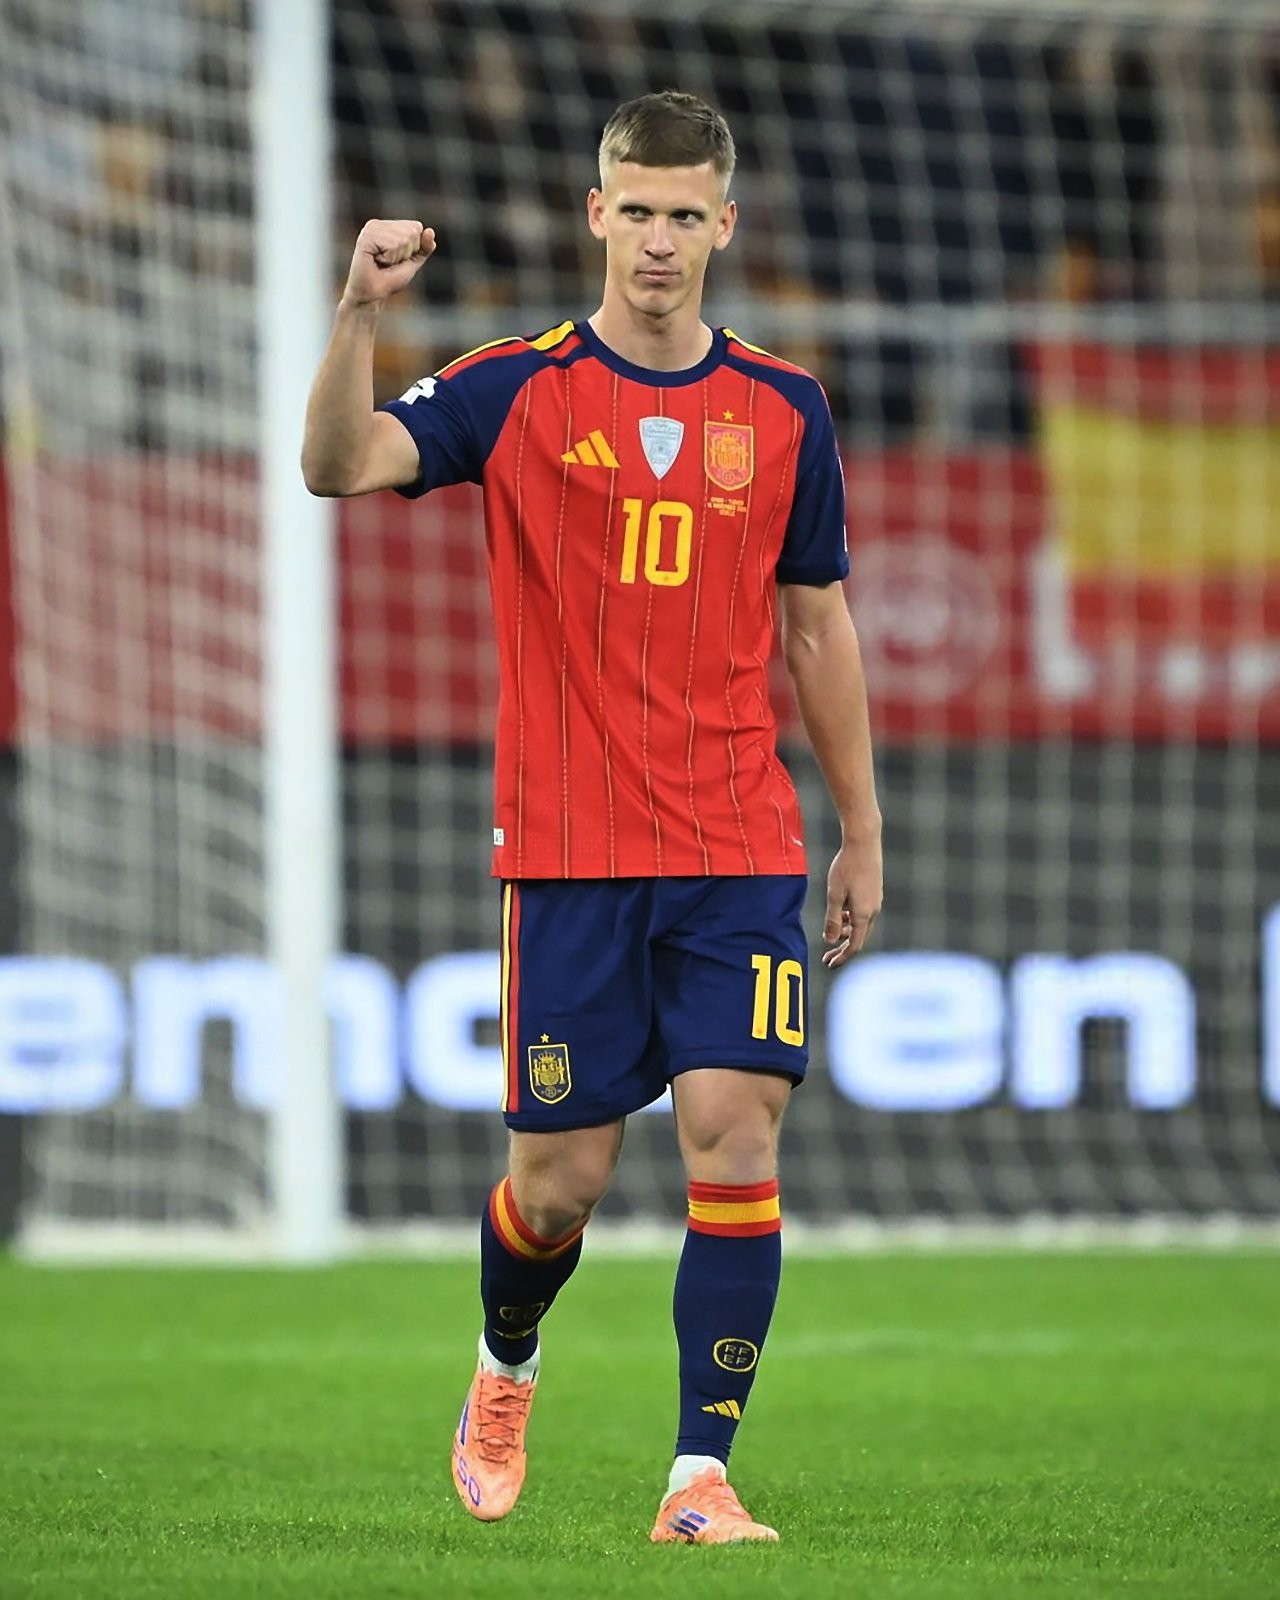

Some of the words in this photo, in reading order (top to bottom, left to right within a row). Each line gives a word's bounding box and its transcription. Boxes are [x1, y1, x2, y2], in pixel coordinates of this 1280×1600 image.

[620, 498, 693, 587] 10
[751, 953, 805, 1047] 10
[827, 951, 1197, 1111] en
